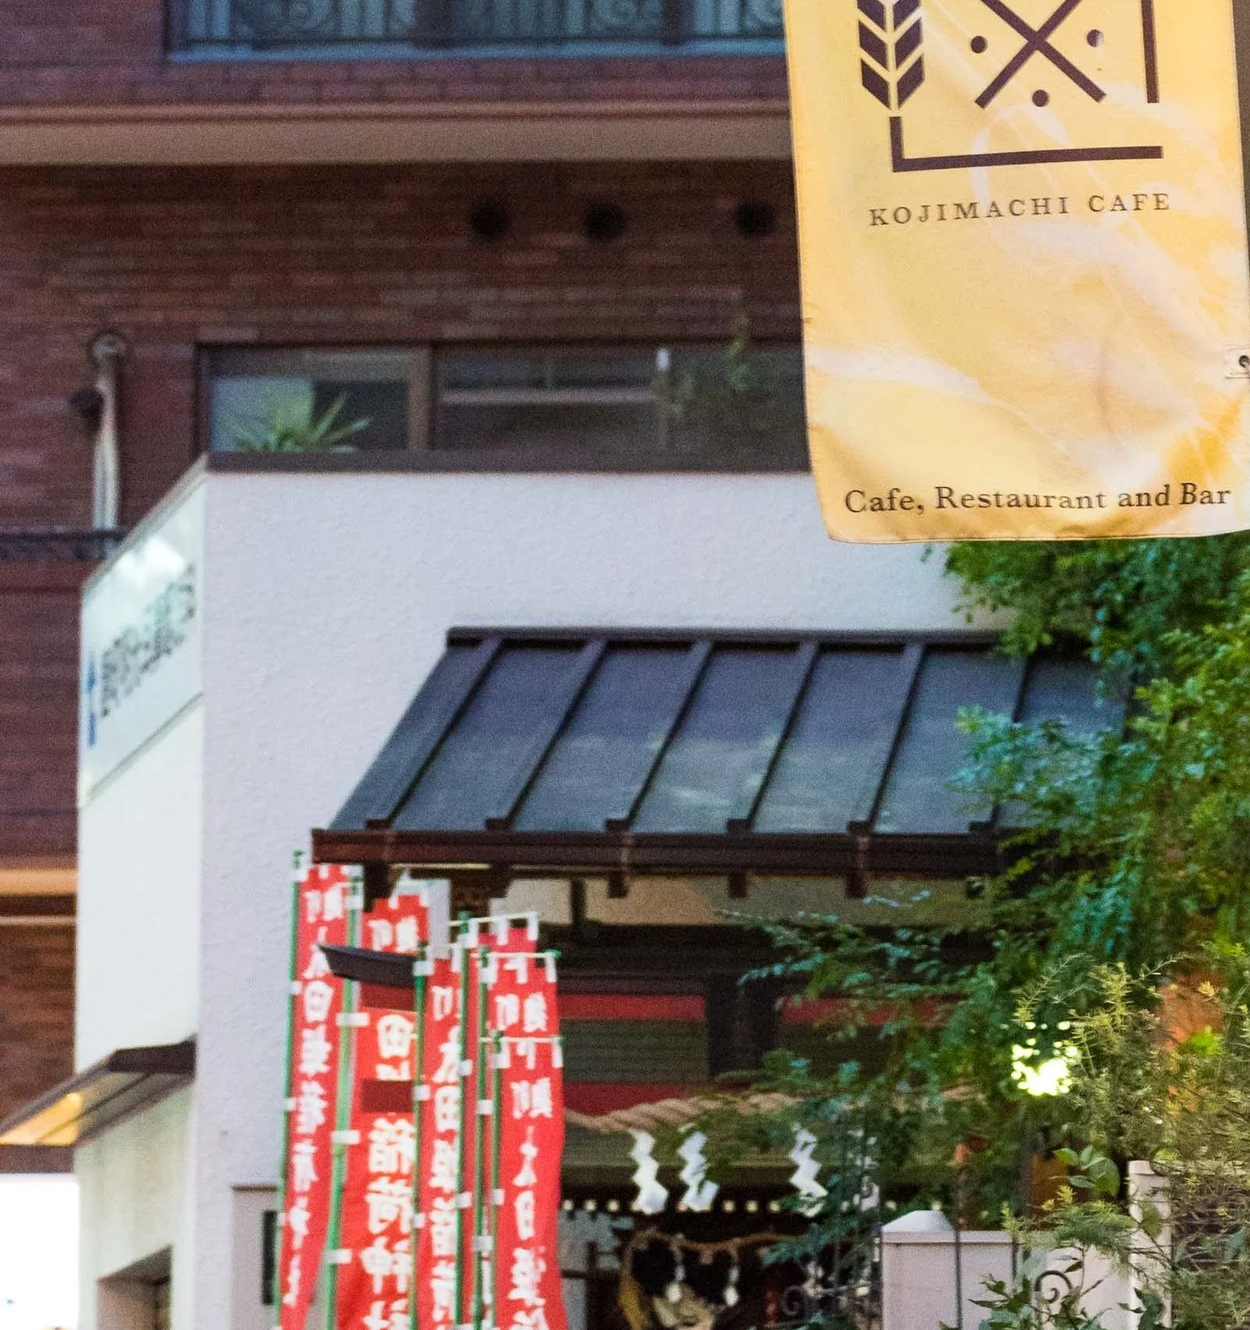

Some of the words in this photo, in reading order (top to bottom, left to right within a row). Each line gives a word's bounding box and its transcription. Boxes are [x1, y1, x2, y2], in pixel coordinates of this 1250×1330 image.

[868, 195, 1071, 227] KOJIMACHI
[1087, 192, 1171, 213] CAFE
[844, 487, 925, 516] Cafe,
[935, 485, 1109, 511] Restaurant
[1117, 484, 1170, 509] and
[1177, 481, 1232, 506] Bar
